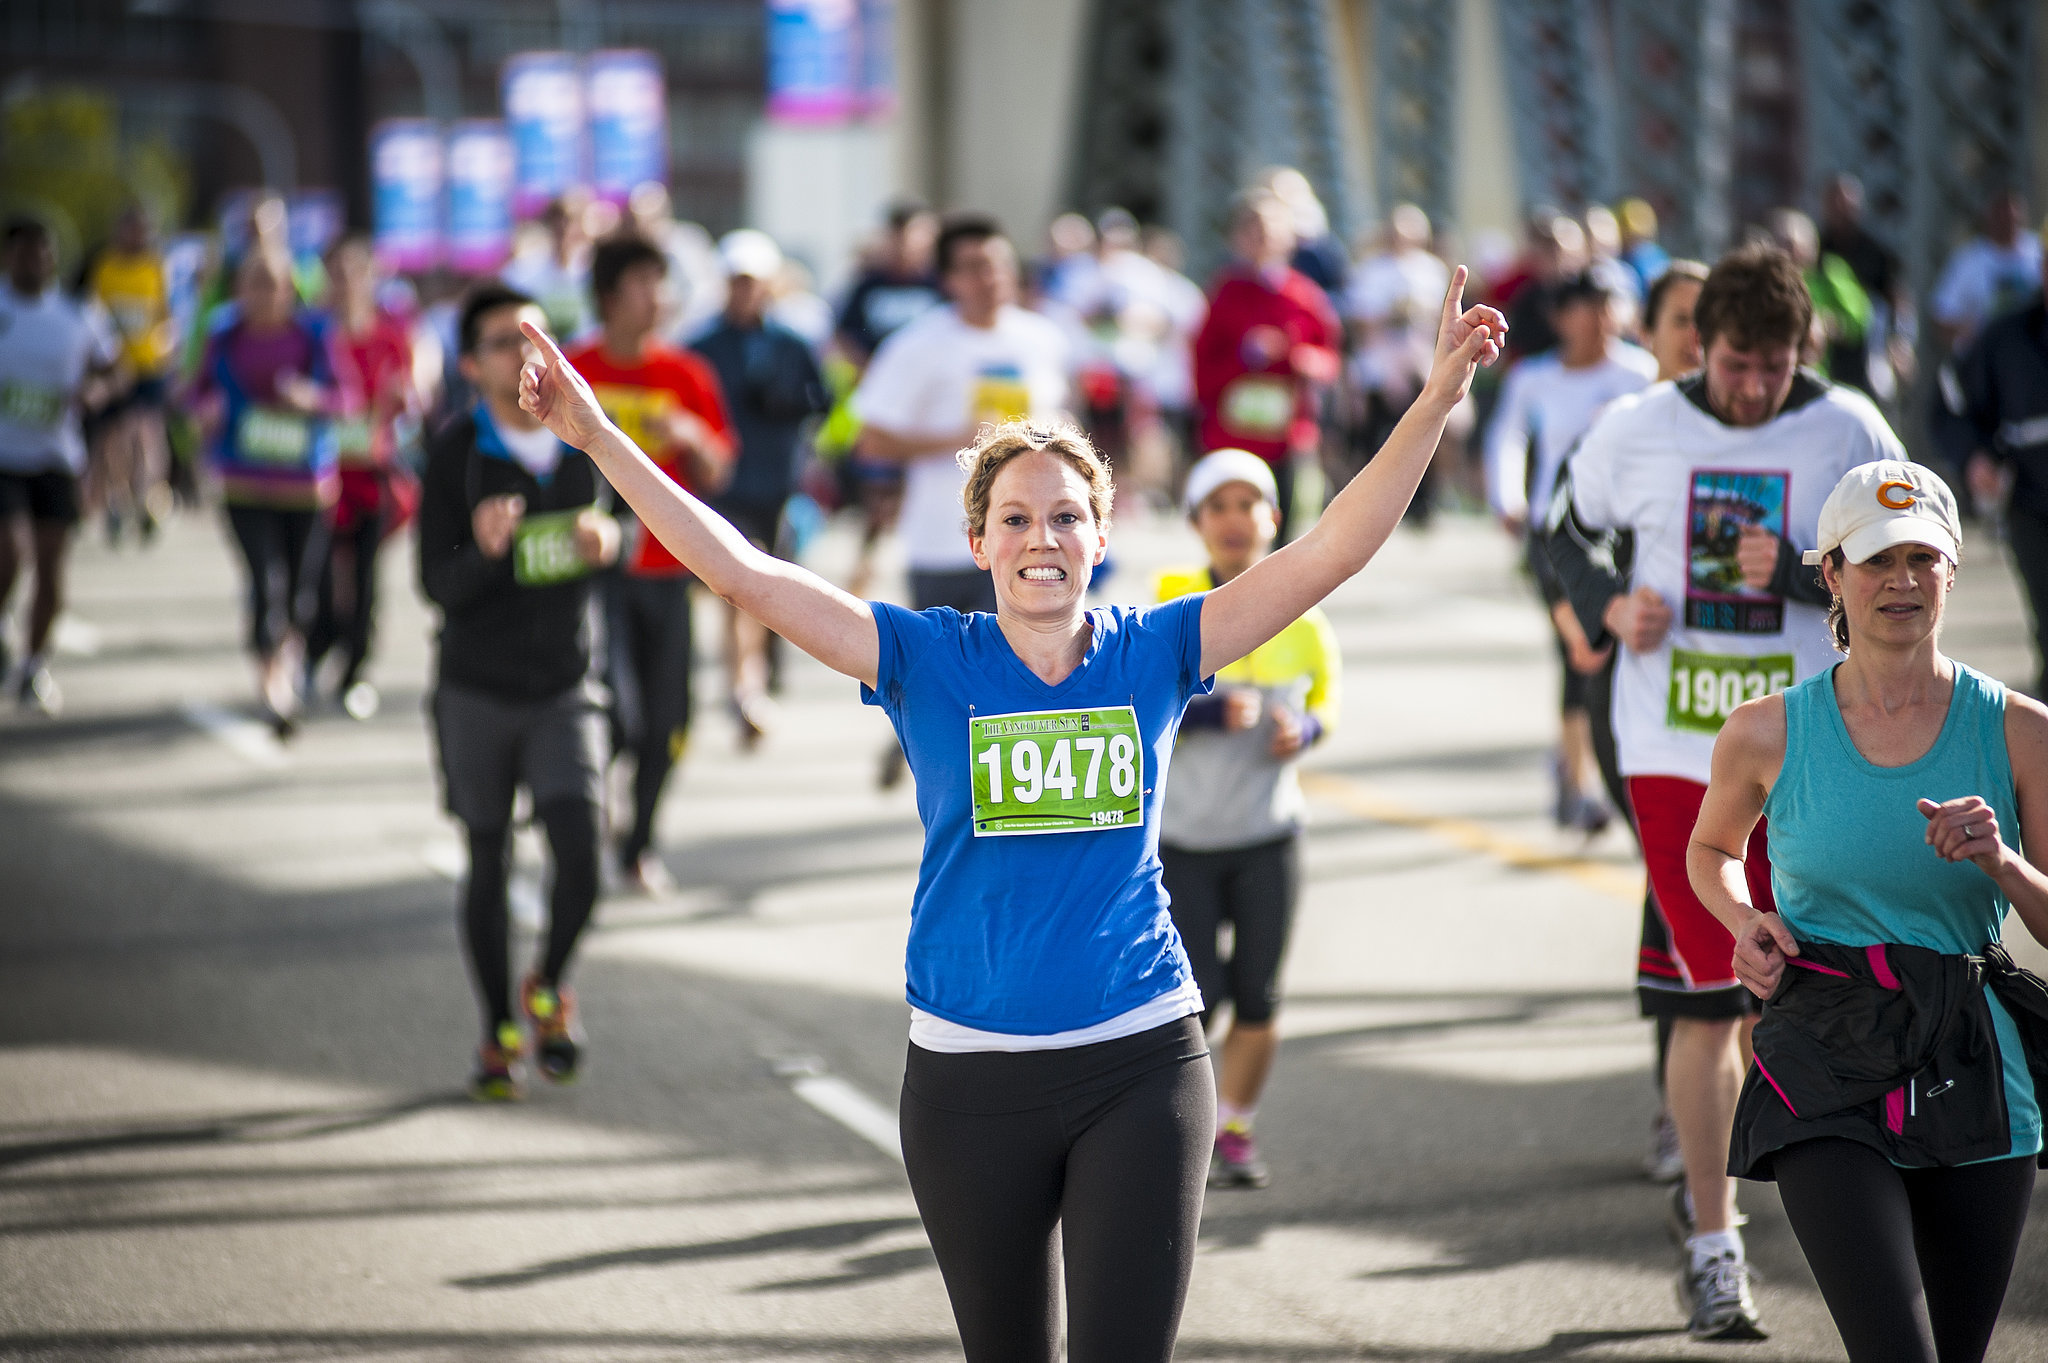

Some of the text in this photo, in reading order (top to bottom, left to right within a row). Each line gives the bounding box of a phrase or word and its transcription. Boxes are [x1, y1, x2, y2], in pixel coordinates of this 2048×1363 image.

[1877, 481, 1916, 509] C
[983, 722, 1001, 735] THE
[1002, 719, 1057, 733] VANCOUVER
[1059, 717, 1078, 729] SUN
[978, 734, 1136, 804] 19478
[1090, 810, 1124, 825] 19478
